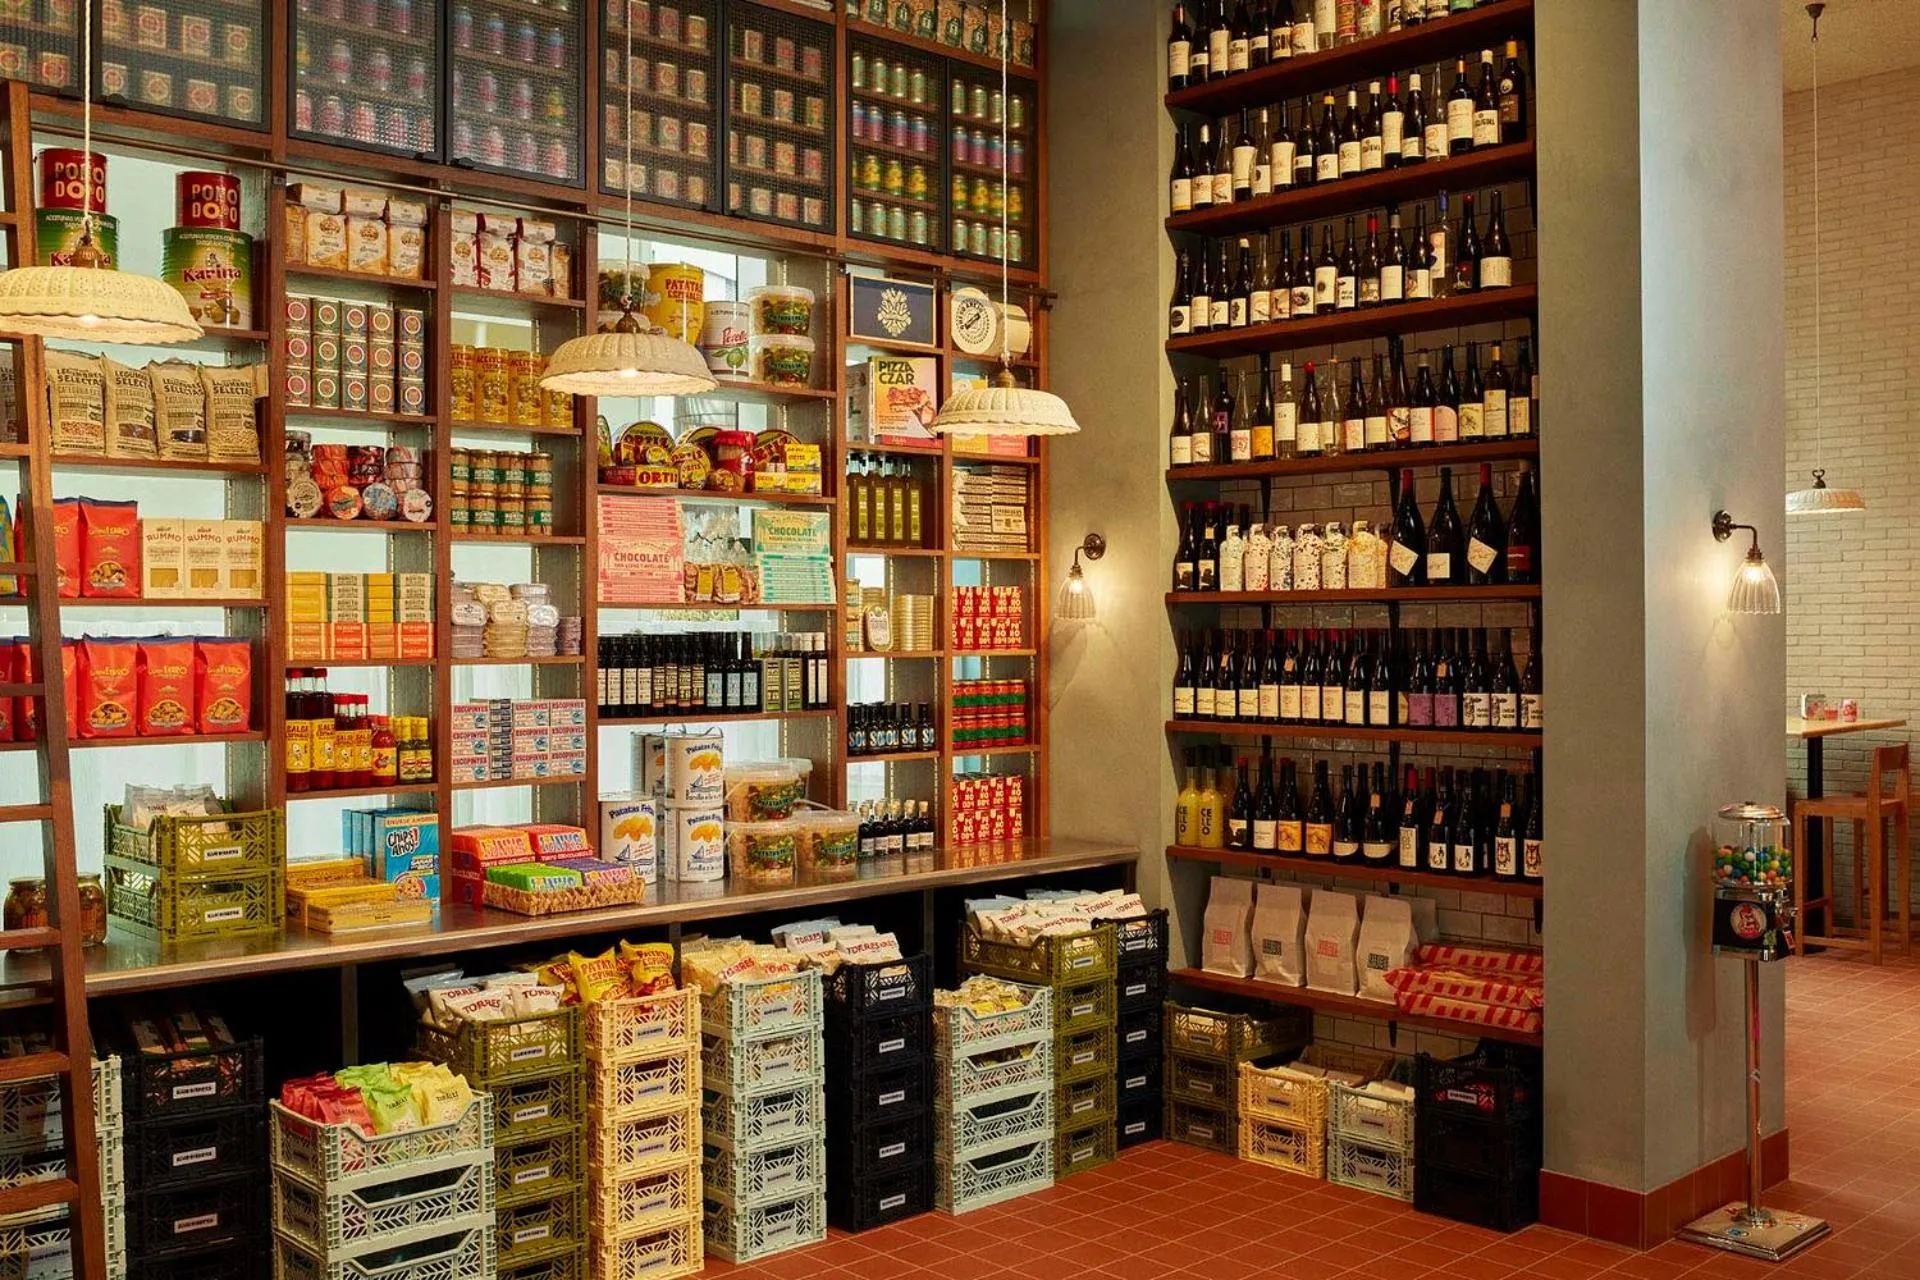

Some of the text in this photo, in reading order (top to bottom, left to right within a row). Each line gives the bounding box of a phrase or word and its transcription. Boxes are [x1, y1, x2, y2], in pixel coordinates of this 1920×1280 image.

[55, 181, 105, 203] DOO
[879, 360, 915, 373] PIZZA
[878, 372, 915, 385] CZAR
[769, 526, 816, 537] CHOCOLATE
[146, 533, 182, 543] RUMMO
[187, 533, 222, 544] RUMMO
[227, 535, 261, 545] RUMMO
[614, 552, 670, 563] CHOCOLATE
[686, 743, 711, 755] Patatas
[608, 806, 640, 820] Patatas
[687, 815, 711, 826] Patatas
[461, 998, 500, 1014] TORRES
